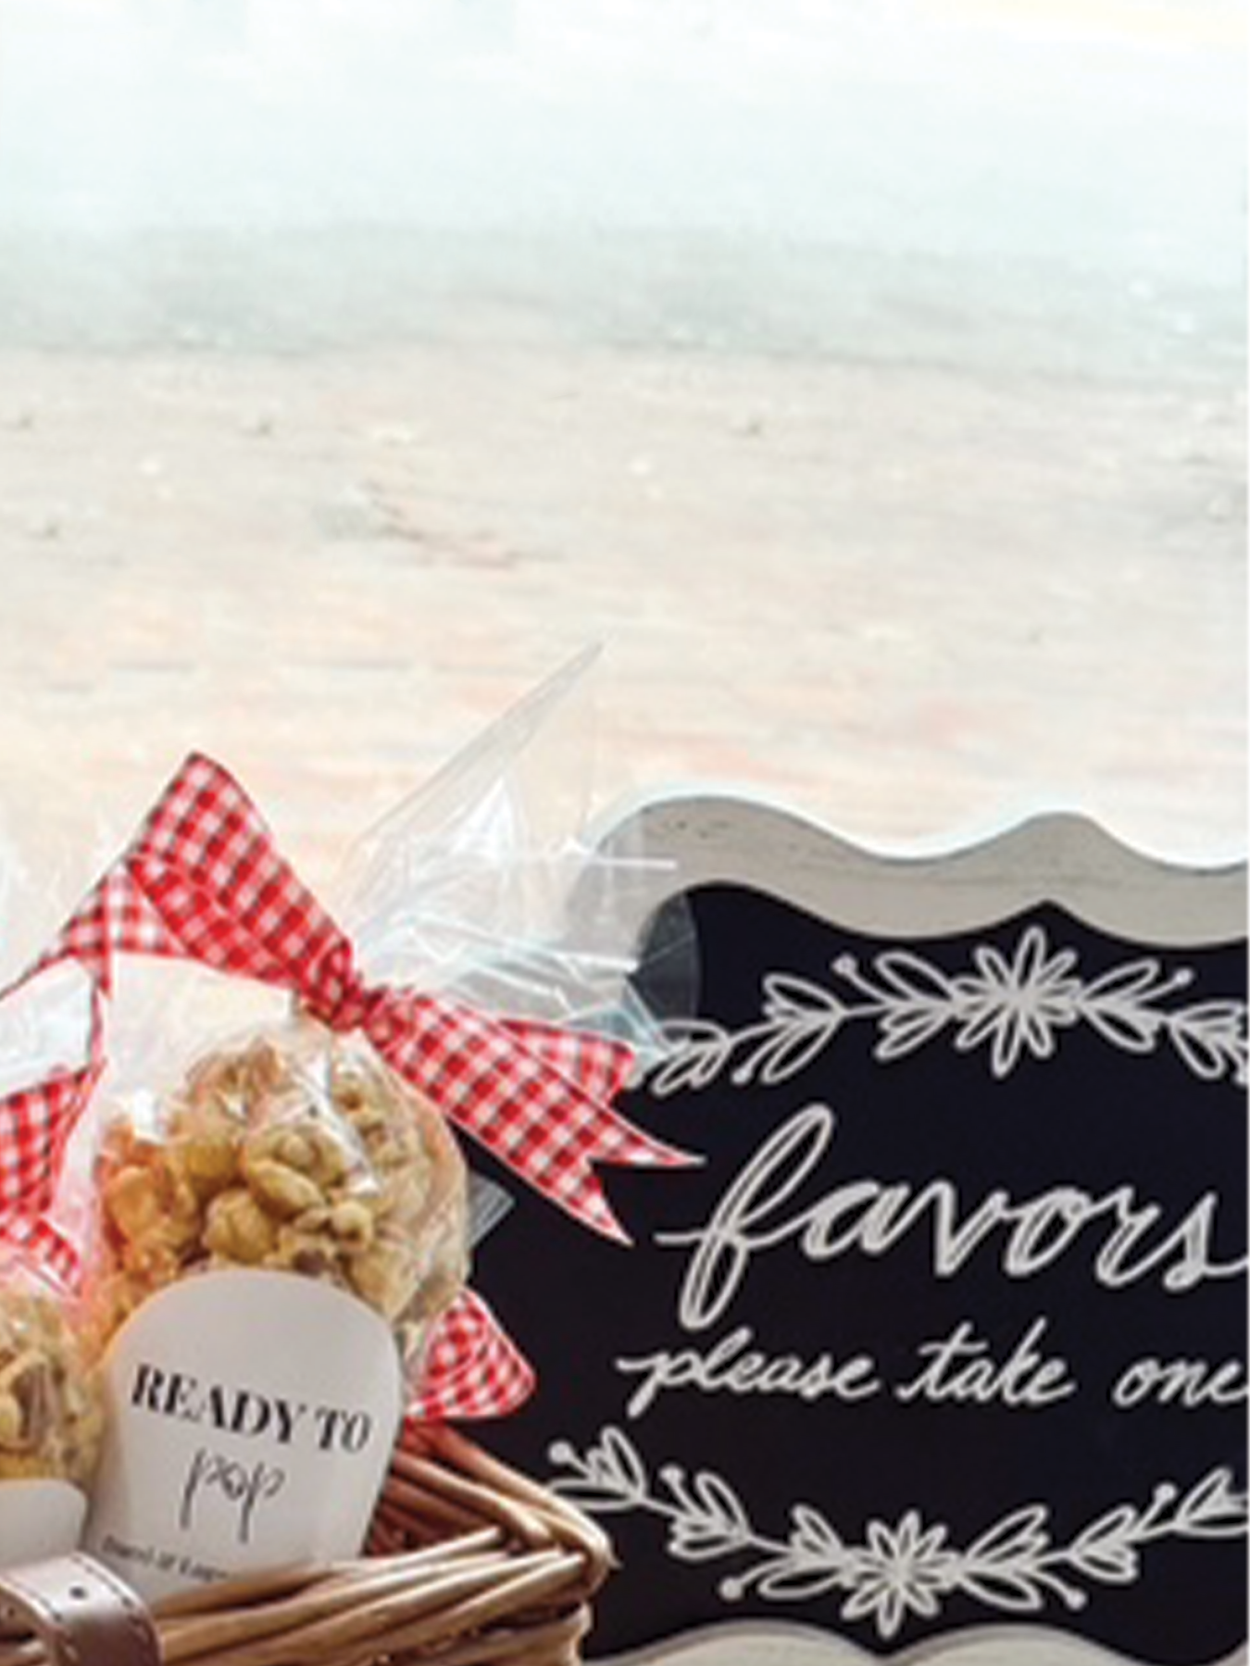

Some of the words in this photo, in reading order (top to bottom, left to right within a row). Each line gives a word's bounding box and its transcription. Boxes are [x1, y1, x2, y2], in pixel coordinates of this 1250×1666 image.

[653, 1103, 1248, 1329] favors
[131, 1362, 307, 1444] READY
[315, 1406, 372, 1454] TO
[615, 1326, 881, 1418] please
[894, 1316, 1078, 1406] take
[1113, 1358, 1248, 1407] one
[180, 1447, 286, 1544] pop
